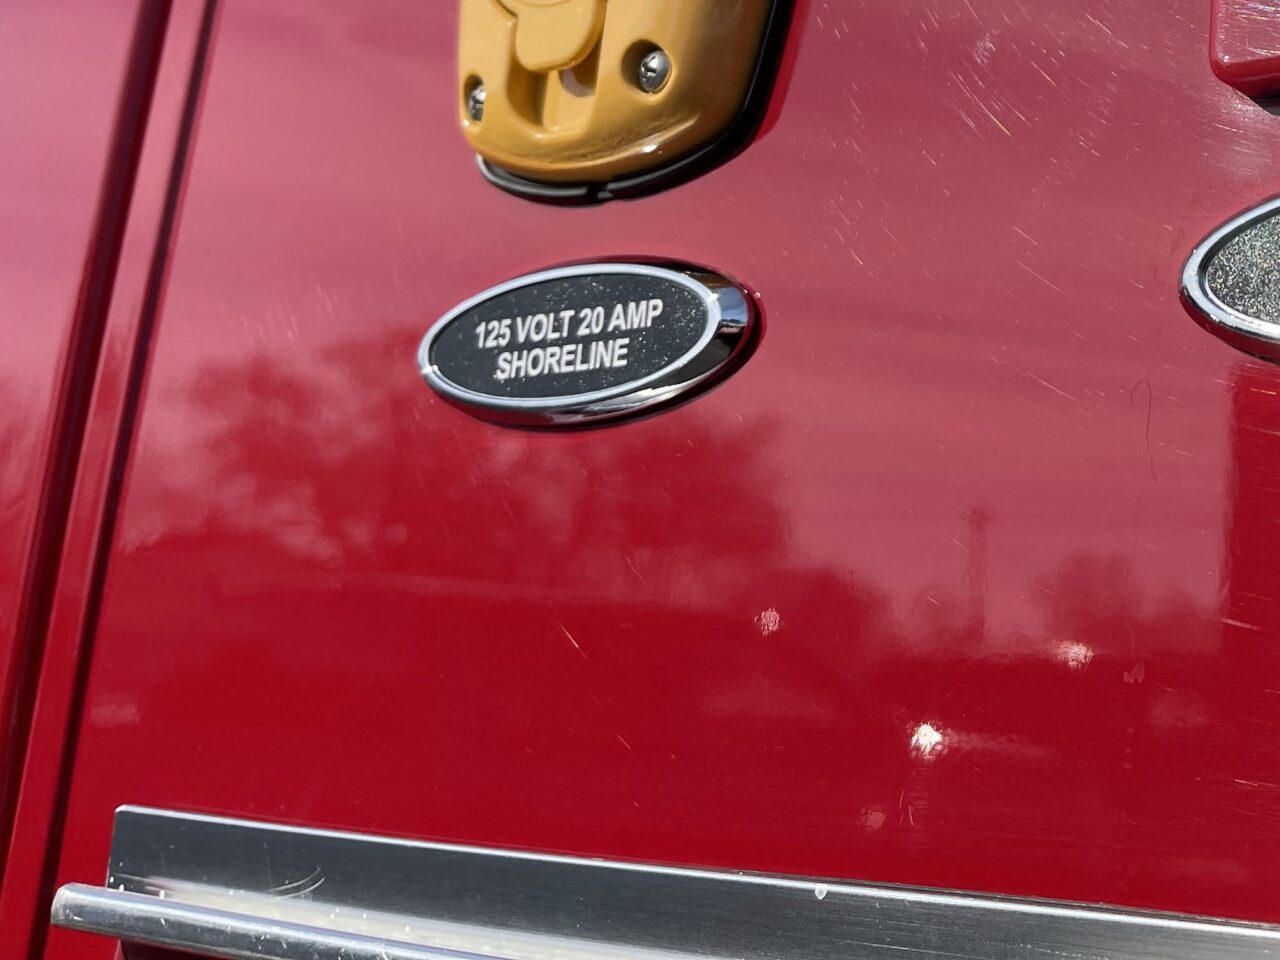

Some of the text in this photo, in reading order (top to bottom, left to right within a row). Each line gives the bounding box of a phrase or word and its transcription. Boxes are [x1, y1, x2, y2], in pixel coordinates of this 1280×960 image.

[475, 297, 664, 349] 125 VOLT 20 AMP
[495, 337, 631, 381] SHORELINE
